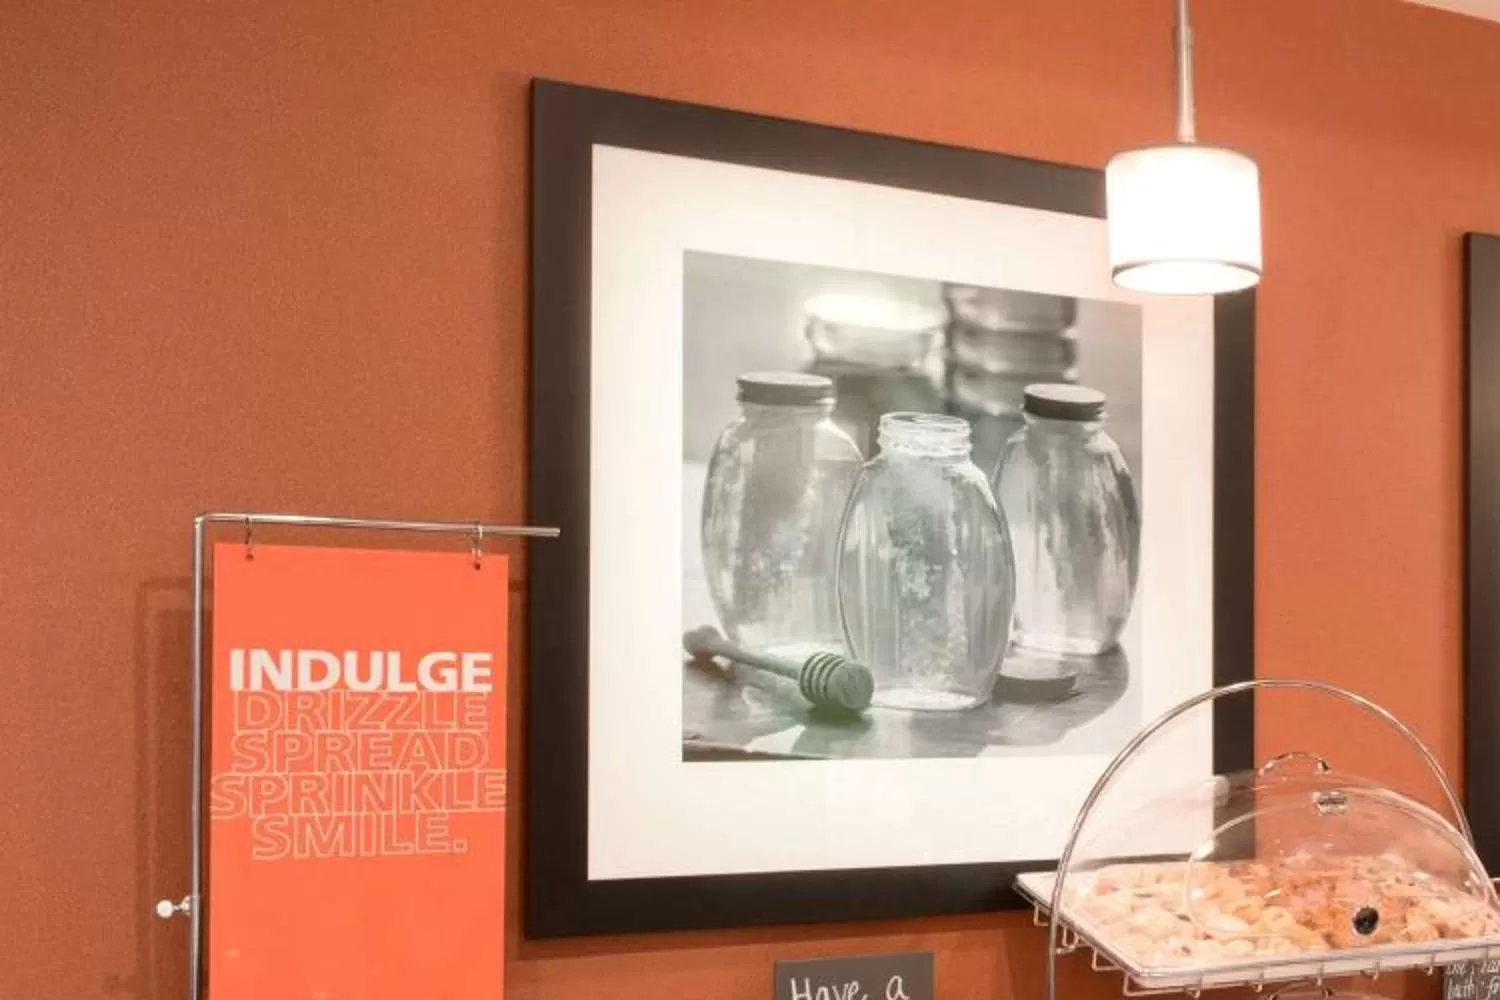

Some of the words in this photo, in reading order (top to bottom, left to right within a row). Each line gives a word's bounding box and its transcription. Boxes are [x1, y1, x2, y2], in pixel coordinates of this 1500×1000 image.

[229, 648, 493, 692] INDULGE
[233, 688, 489, 734] DRIZZLE
[231, 730, 490, 774] SPREAD
[209, 769, 507, 819] SPRINKLE
[252, 812, 468, 860] SMILE.
